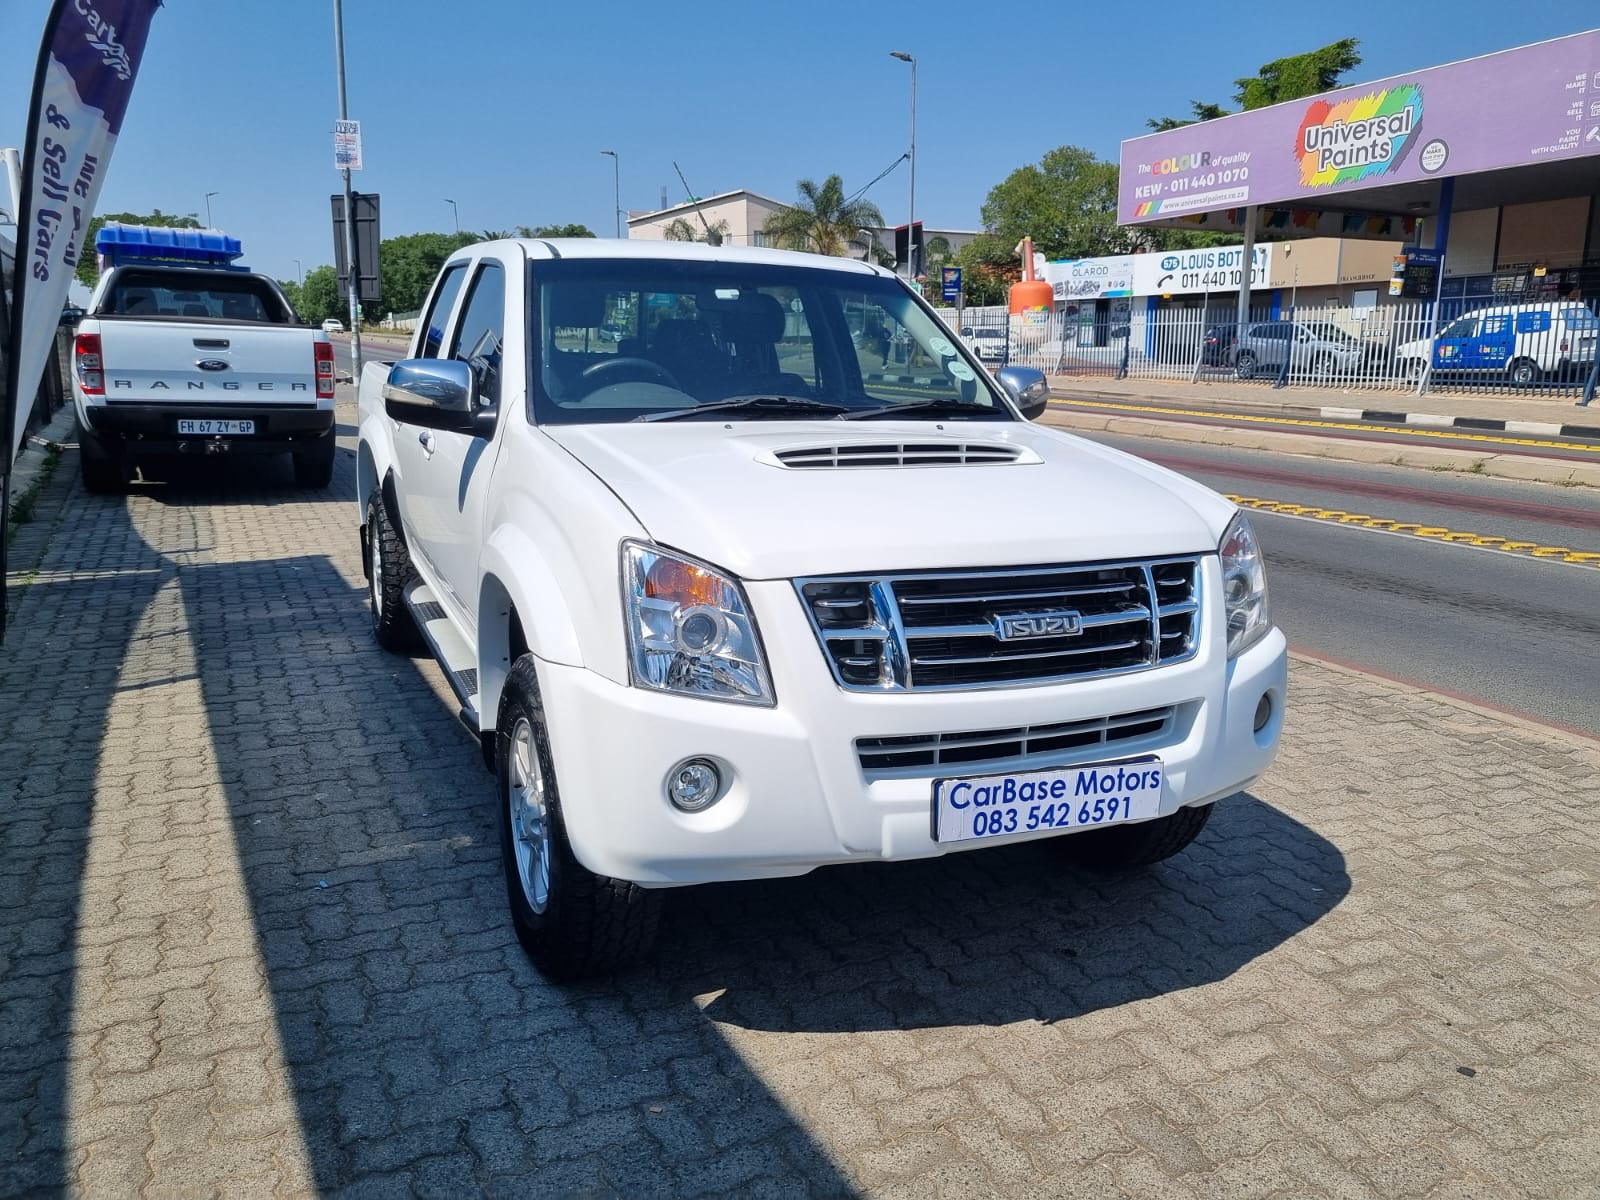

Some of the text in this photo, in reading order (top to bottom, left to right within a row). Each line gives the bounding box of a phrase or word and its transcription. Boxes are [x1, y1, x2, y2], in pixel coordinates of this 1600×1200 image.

[1565, 80, 1586, 89] MAKE
[1575, 73, 1587, 81] WE
[1566, 107, 1583, 116] SELL
[1572, 100, 1584, 108] WE
[1305, 107, 1411, 151] Universal
[1320, 139, 1391, 170] Paints
[1531, 142, 1579, 155] WITH QUALITY
[42, 137, 70, 204] Sell
[1138, 151, 1251, 176] The COLOUR of quality
[1135, 183, 1163, 199] KEW
[1170, 178, 1189, 192] 011
[1191, 173, 1215, 189] 440
[1217, 167, 1249, 184] 1070
[1181, 253, 1214, 270] LOUIS
[1218, 249, 1258, 268] BOTA
[1181, 273, 1199, 288] 011
[1202, 271, 1226, 287] 440
[114, 379, 307, 392] RANGER
[180, 421, 252, 433] FH 67 ZY GP
[1004, 616, 1079, 638] ISUZU
[949, 767, 1161, 810] CarBase Motors
[973, 796, 1131, 837] 083 542 6591
